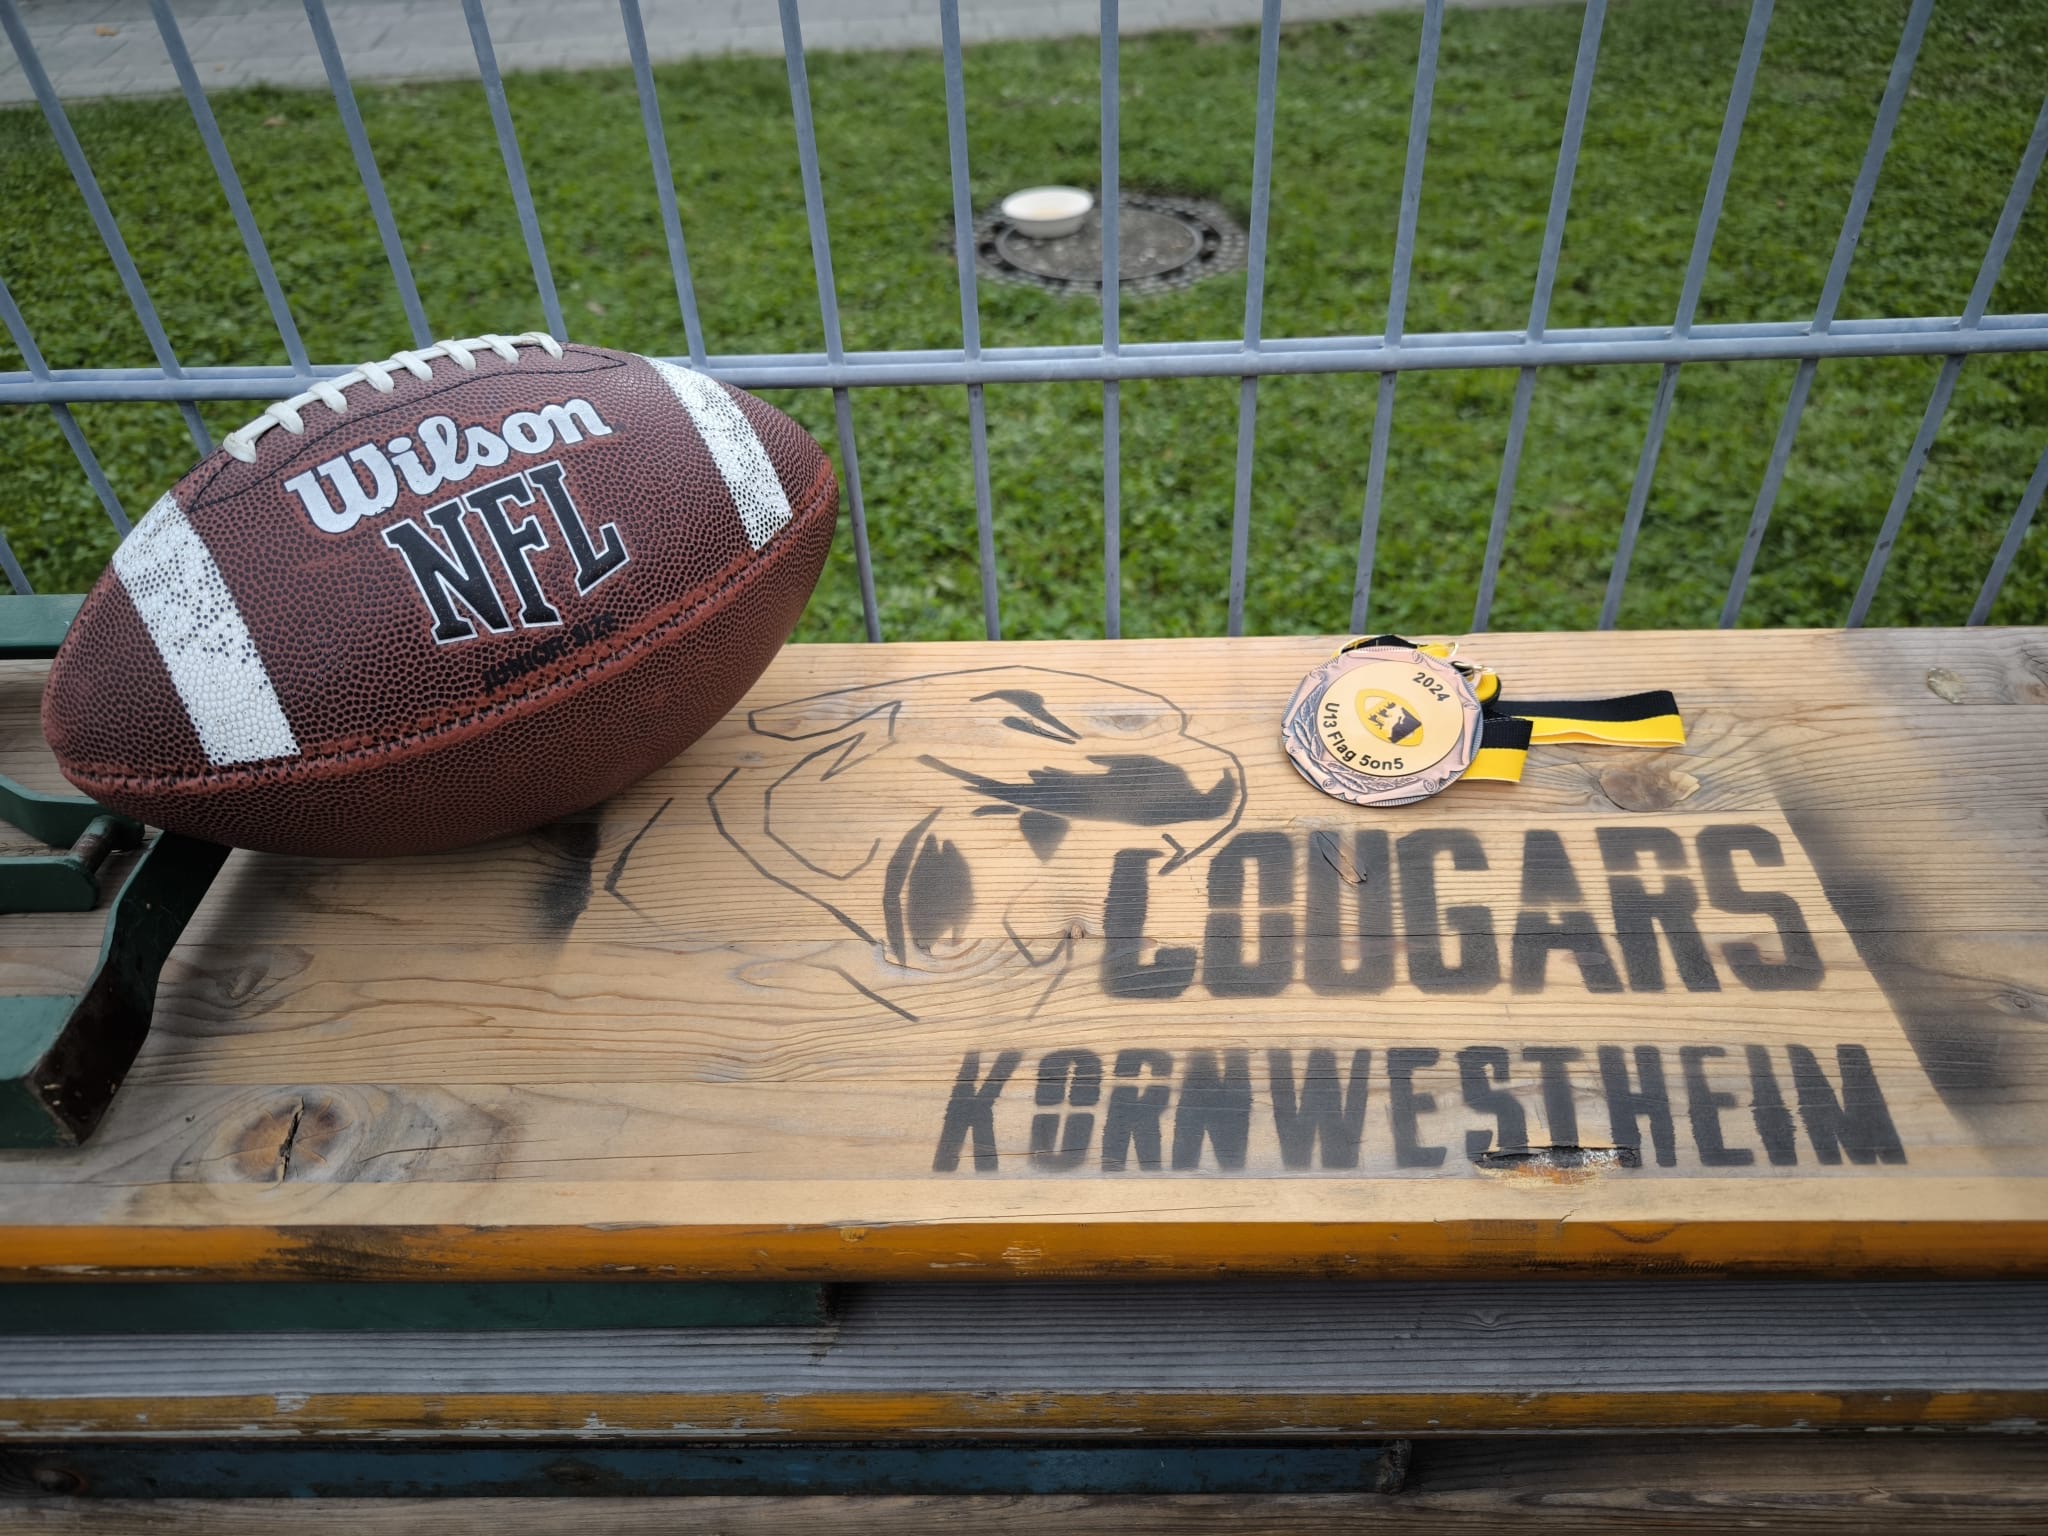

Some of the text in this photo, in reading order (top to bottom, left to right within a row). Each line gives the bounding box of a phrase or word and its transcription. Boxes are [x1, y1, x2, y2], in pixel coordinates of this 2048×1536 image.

[283, 397, 614, 535] Wilson
[380, 459, 631, 645] NFL
[1323, 702, 1404, 771] U13 Flag 5on5
[1412, 671, 1450, 702] 2024
[1101, 824, 1828, 999] COUGARS
[931, 1043, 1908, 1174] KORNWESTHEIM
